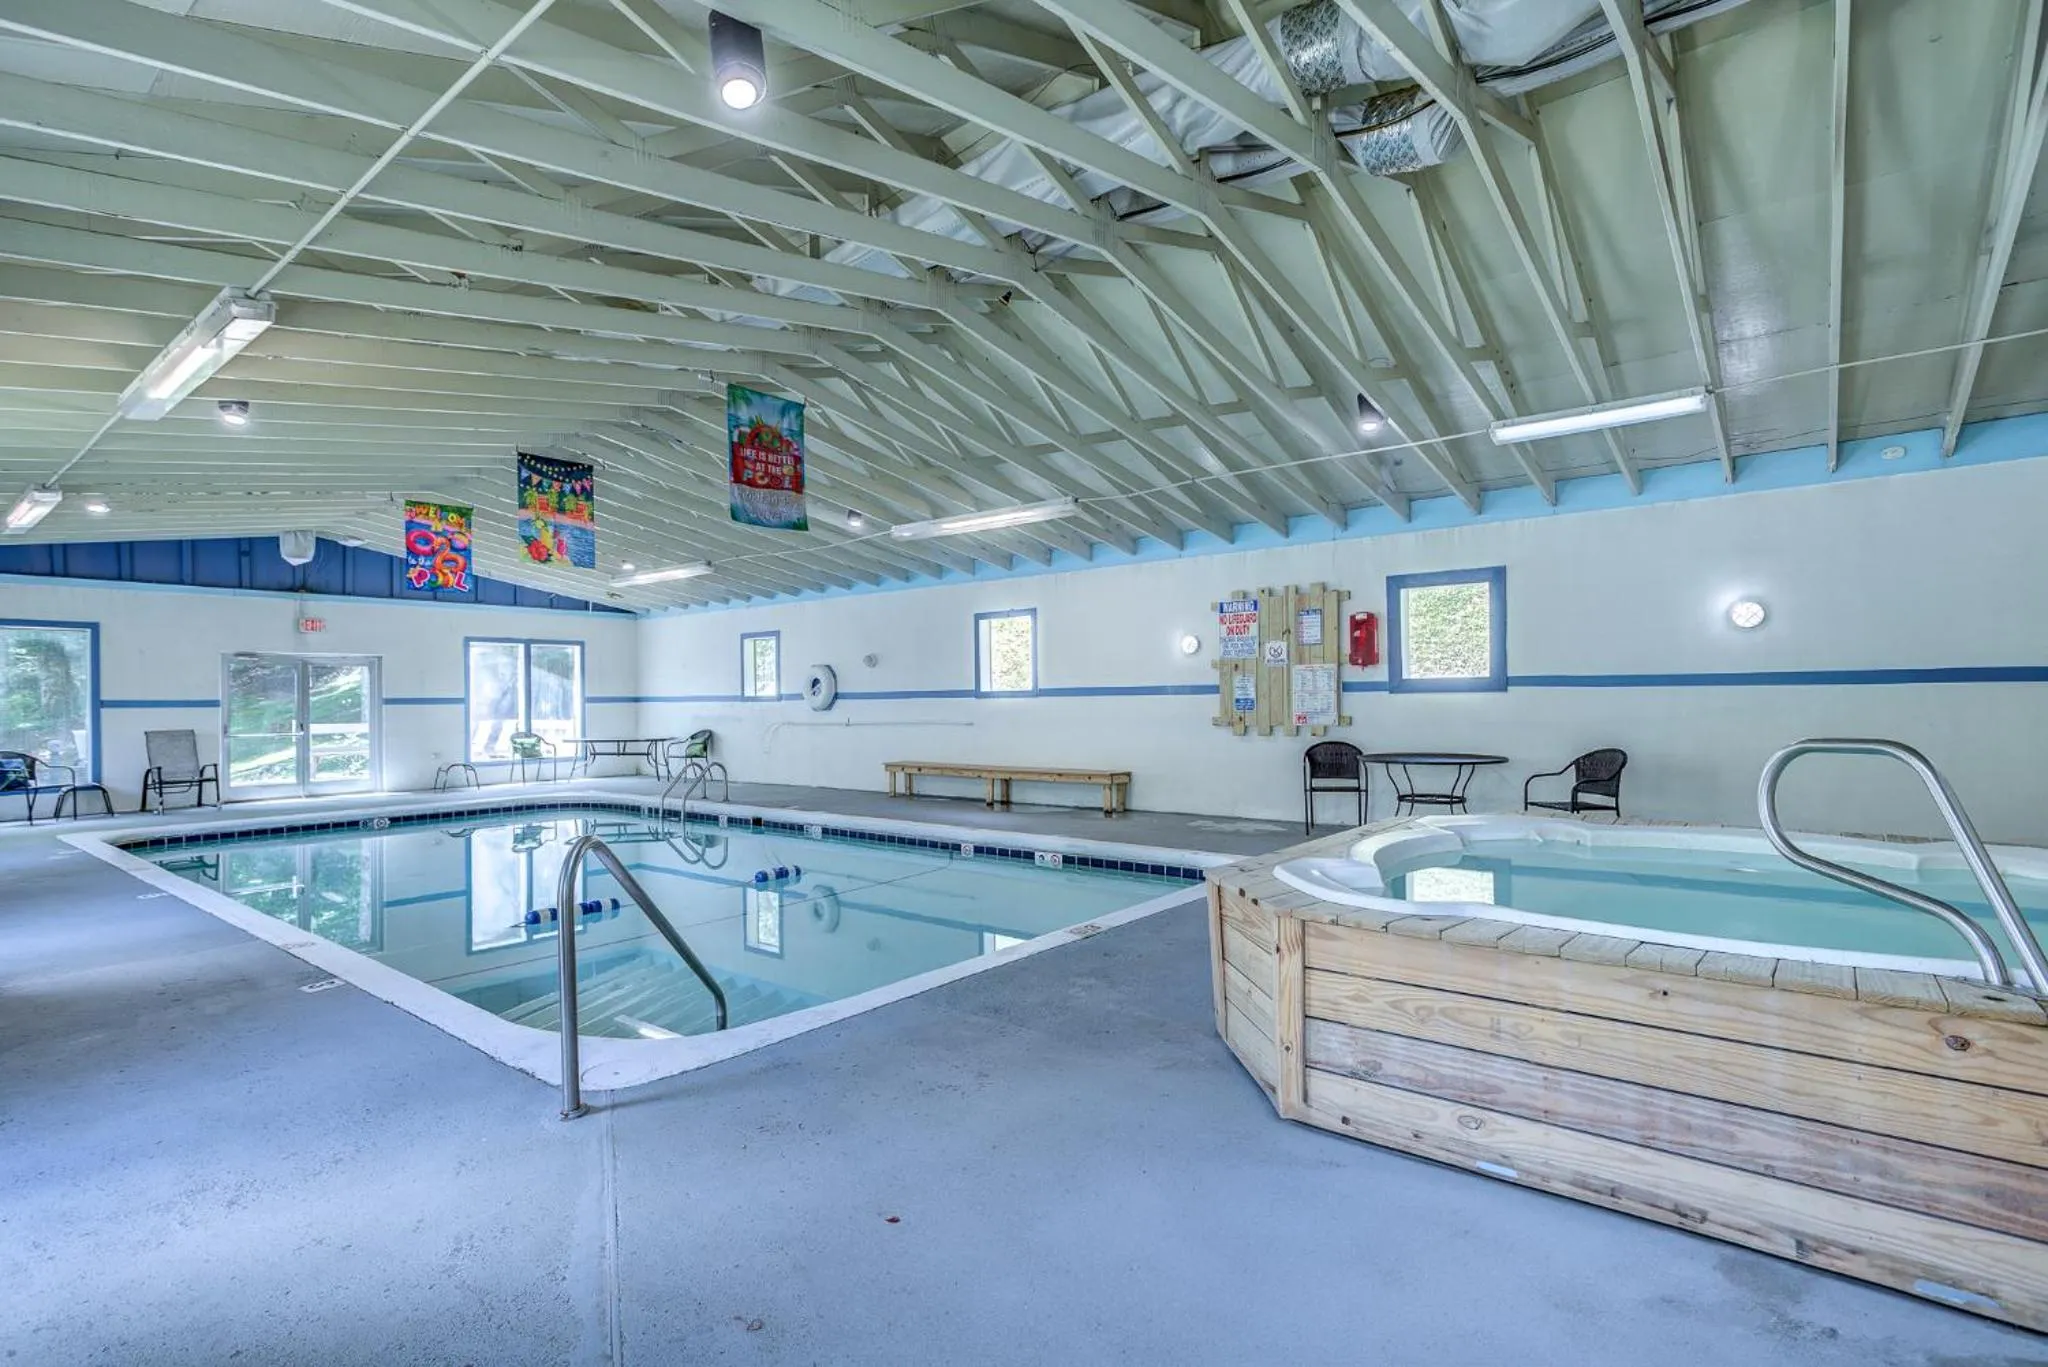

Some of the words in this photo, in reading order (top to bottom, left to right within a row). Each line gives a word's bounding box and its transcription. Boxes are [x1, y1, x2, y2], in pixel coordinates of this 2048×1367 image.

[758, 451, 767, 461] IS
[755, 462, 765, 472] AT
[767, 464, 782, 476] THE
[412, 567, 469, 592] POOL
[1222, 600, 1255, 612] WARNING
[1218, 614, 1227, 625] NO
[1228, 612, 1257, 624] LIFEGUARD
[1226, 625, 1235, 636] ON
[1235, 625, 1250, 636] DUTY
